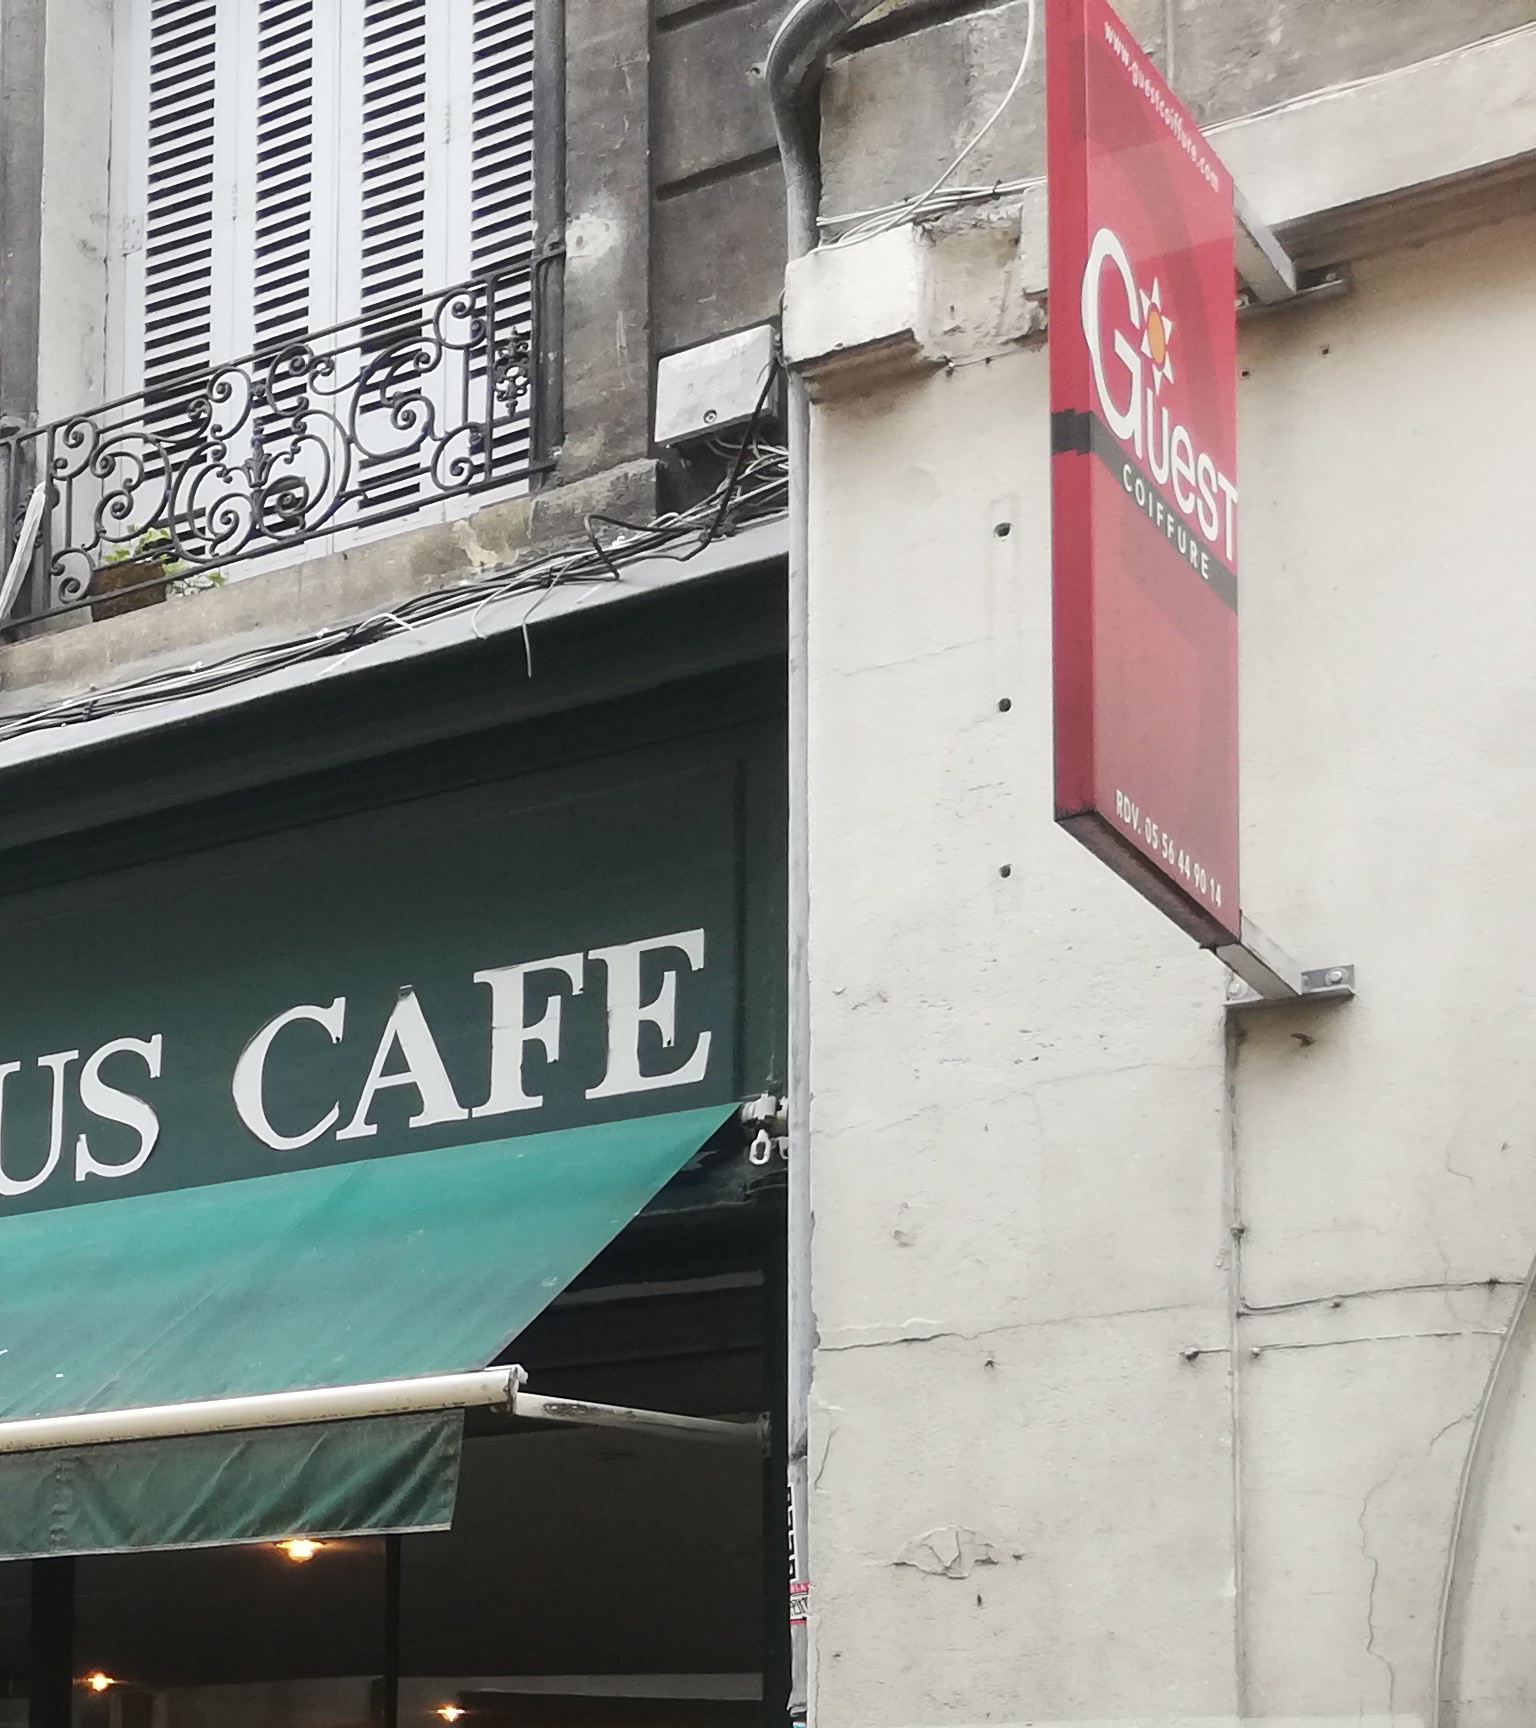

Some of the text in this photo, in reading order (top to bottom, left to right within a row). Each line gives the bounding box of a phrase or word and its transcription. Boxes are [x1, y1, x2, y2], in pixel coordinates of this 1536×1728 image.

[1122, 462, 1210, 581] COIFFURE
[1145, 817, 1159, 849] 05
[1161, 832, 1175, 865] 56
[1177, 849, 1191, 880] 44
[1194, 863, 1207, 894] 90
[1209, 877, 1222, 907] 14
[231, 928, 713, 1153] CAFE
